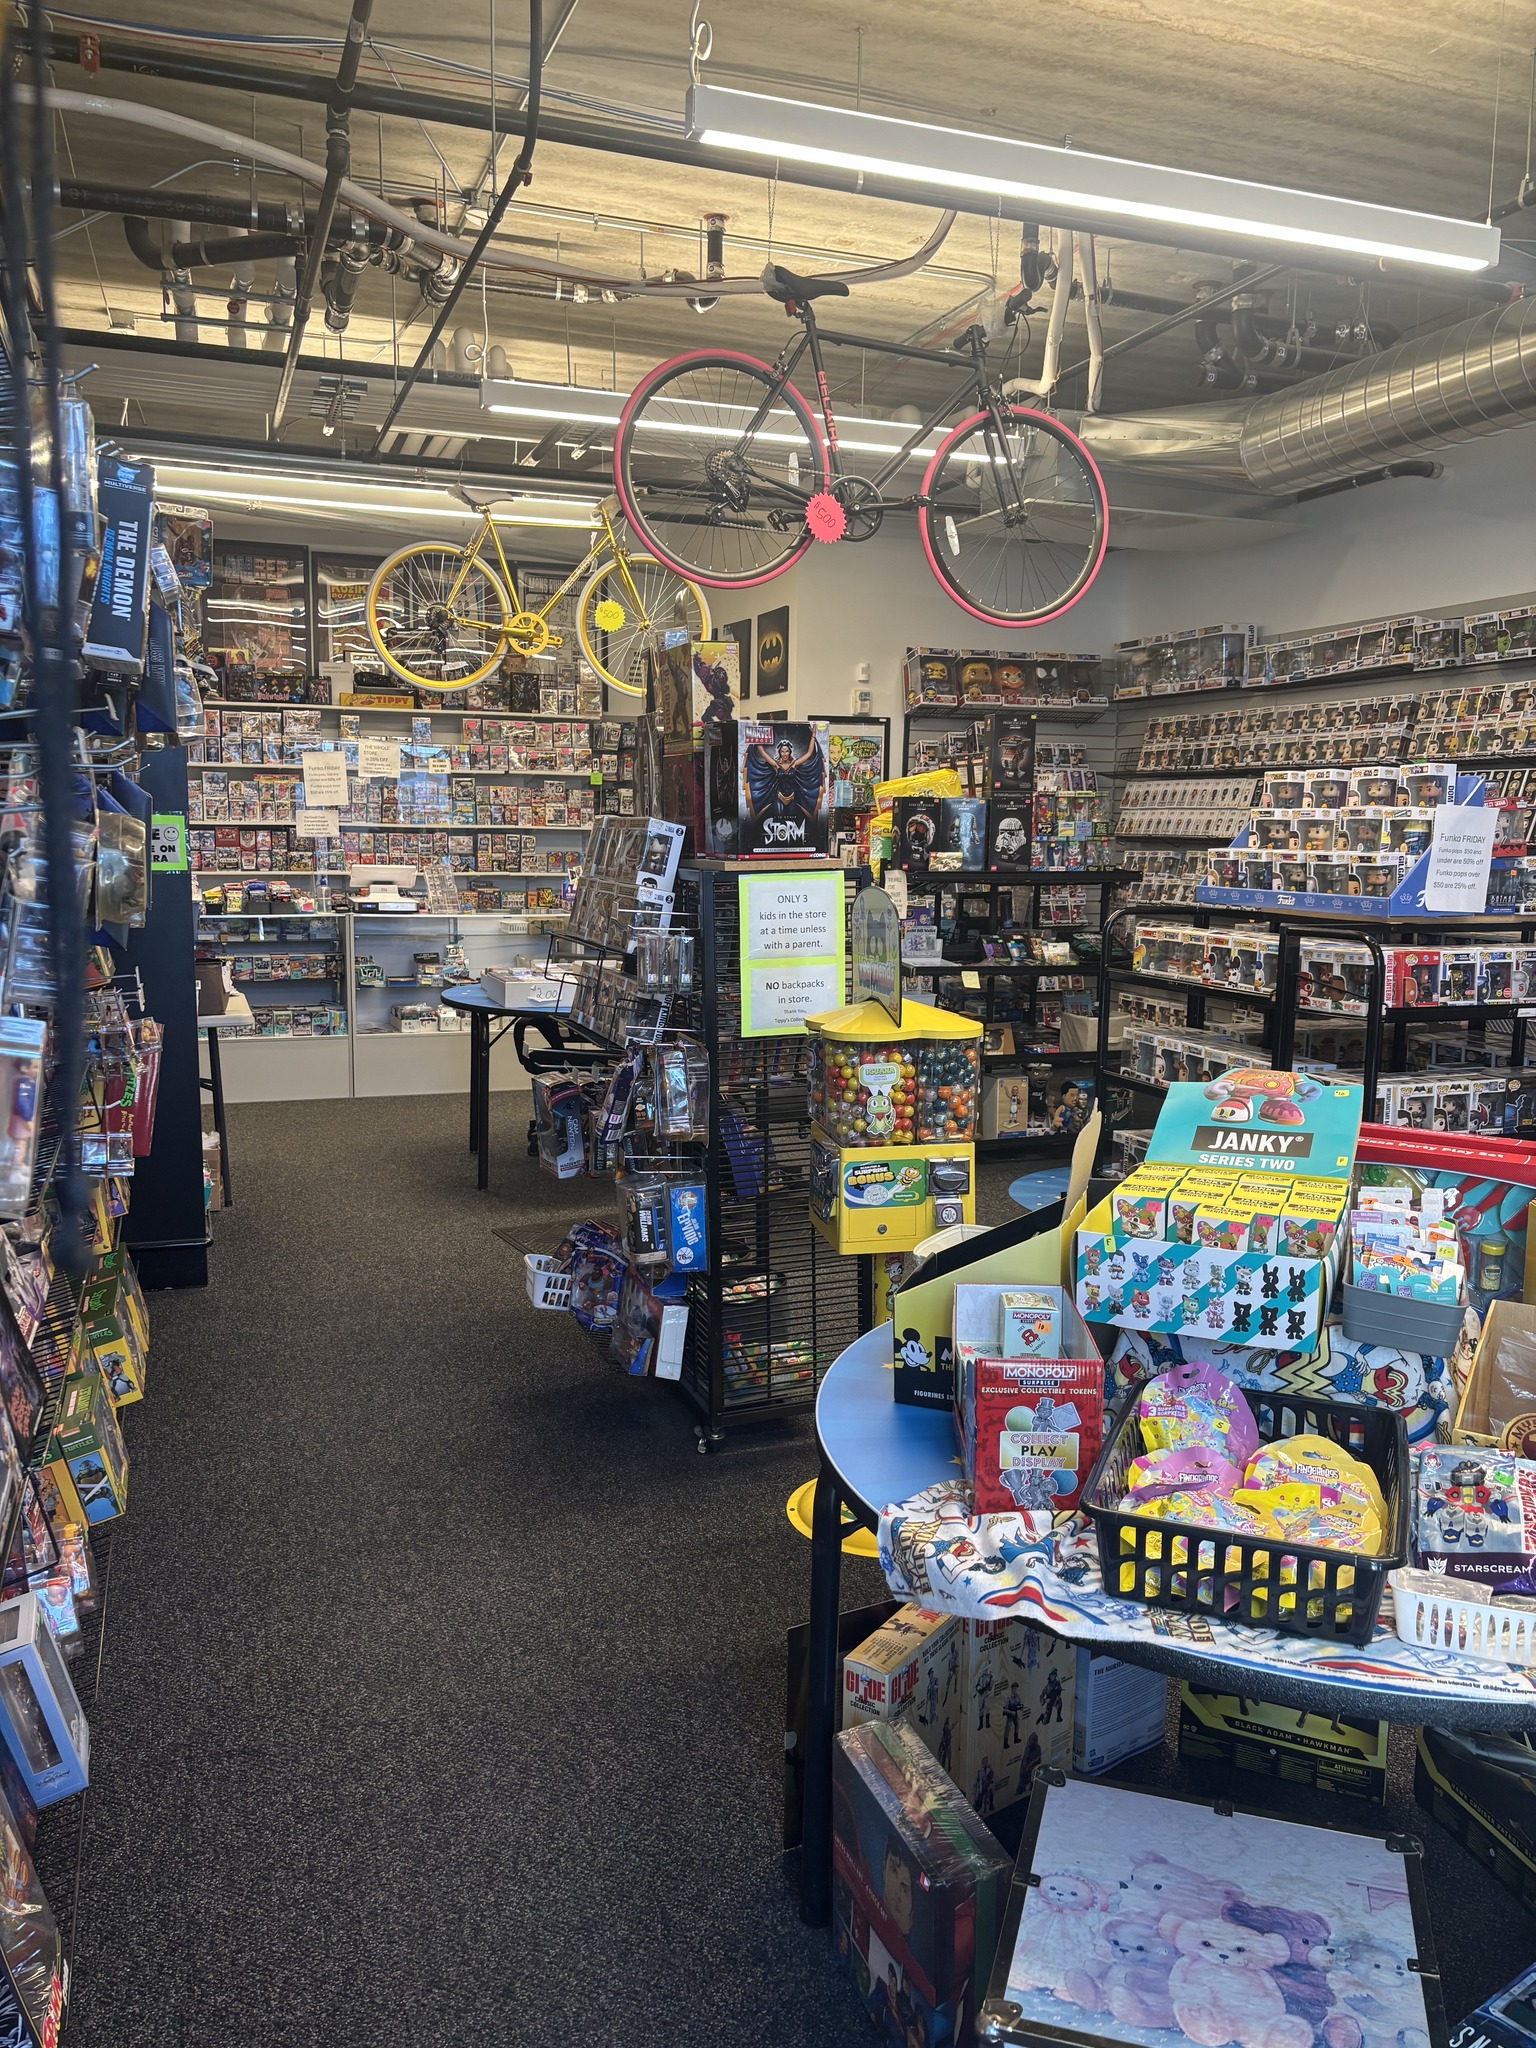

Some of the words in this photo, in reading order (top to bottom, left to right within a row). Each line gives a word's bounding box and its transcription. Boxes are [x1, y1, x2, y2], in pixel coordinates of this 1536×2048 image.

[104, 479, 146, 493] MULTIVERSE
[813, 501, 836, 528] $500
[103, 528, 115, 562] DEMON
[115, 520, 138, 559] THE
[100, 564, 113, 604] KNIGHTS
[112, 560, 136, 621] DEMON
[600, 607, 620, 620] $500
[376, 696, 409, 705] TIPPY
[745, 727, 772, 738] MARVEL
[763, 817, 806, 844] STORM
[1440, 833, 1461, 842] Funko
[1462, 835, 1486, 844] FRIDAY
[1436, 869, 1453, 877] Funko
[777, 895, 800, 904] ONLY
[802, 894, 808, 903] 3
[1277, 894, 1295, 906] Funko
[760, 912, 776, 920] kids
[779, 911, 786, 919] in
[789, 911, 803, 919] the
[805, 911, 826, 919] store
[779, 927, 798, 935] time
[800, 926, 826, 934] unless
[764, 941, 782, 950] with
[792, 940, 823, 950] parent.
[766, 982, 780, 990] NO
[782, 979, 824, 991] backpacks
[778, 996, 786, 1004] in
[788, 995, 812, 1003] store.
[1398, 1143, 1437, 1151] Party
[1198, 1154, 1255, 1167] SERIES
[1260, 1158, 1295, 1171] TWO
[854, 1166, 888, 1176] SURPRISE
[848, 1171, 895, 1186] BONUS
[1213, 1206, 1243, 1214] JANKY
[639, 1210, 649, 1242] WILLIAMS
[677, 1212, 699, 1245] ERVING
[1006, 1367, 1074, 1378] MONOPOLY
[914, 1390, 944, 1399] FIGURINES
[1148, 1407, 1156, 1416] 3
[1011, 1434, 1068, 1444] COLLECT
[1021, 1445, 1057, 1456] PLAY
[1012, 1457, 1066, 1467] DISPLAY
[1454, 1564, 1532, 1574] STARSCREAM
[846, 1670, 859, 1694] GI
[1483, 1685, 1510, 1693] children's
[850, 1700, 880, 1716] COLLECTION
[1235, 1721, 1263, 1733] BLACK
[1335, 1764, 1362, 1775] ATTENTION
[1470, 1799, 1495, 1827] CRUISER
[1496, 1824, 1521, 1848] PATROL
